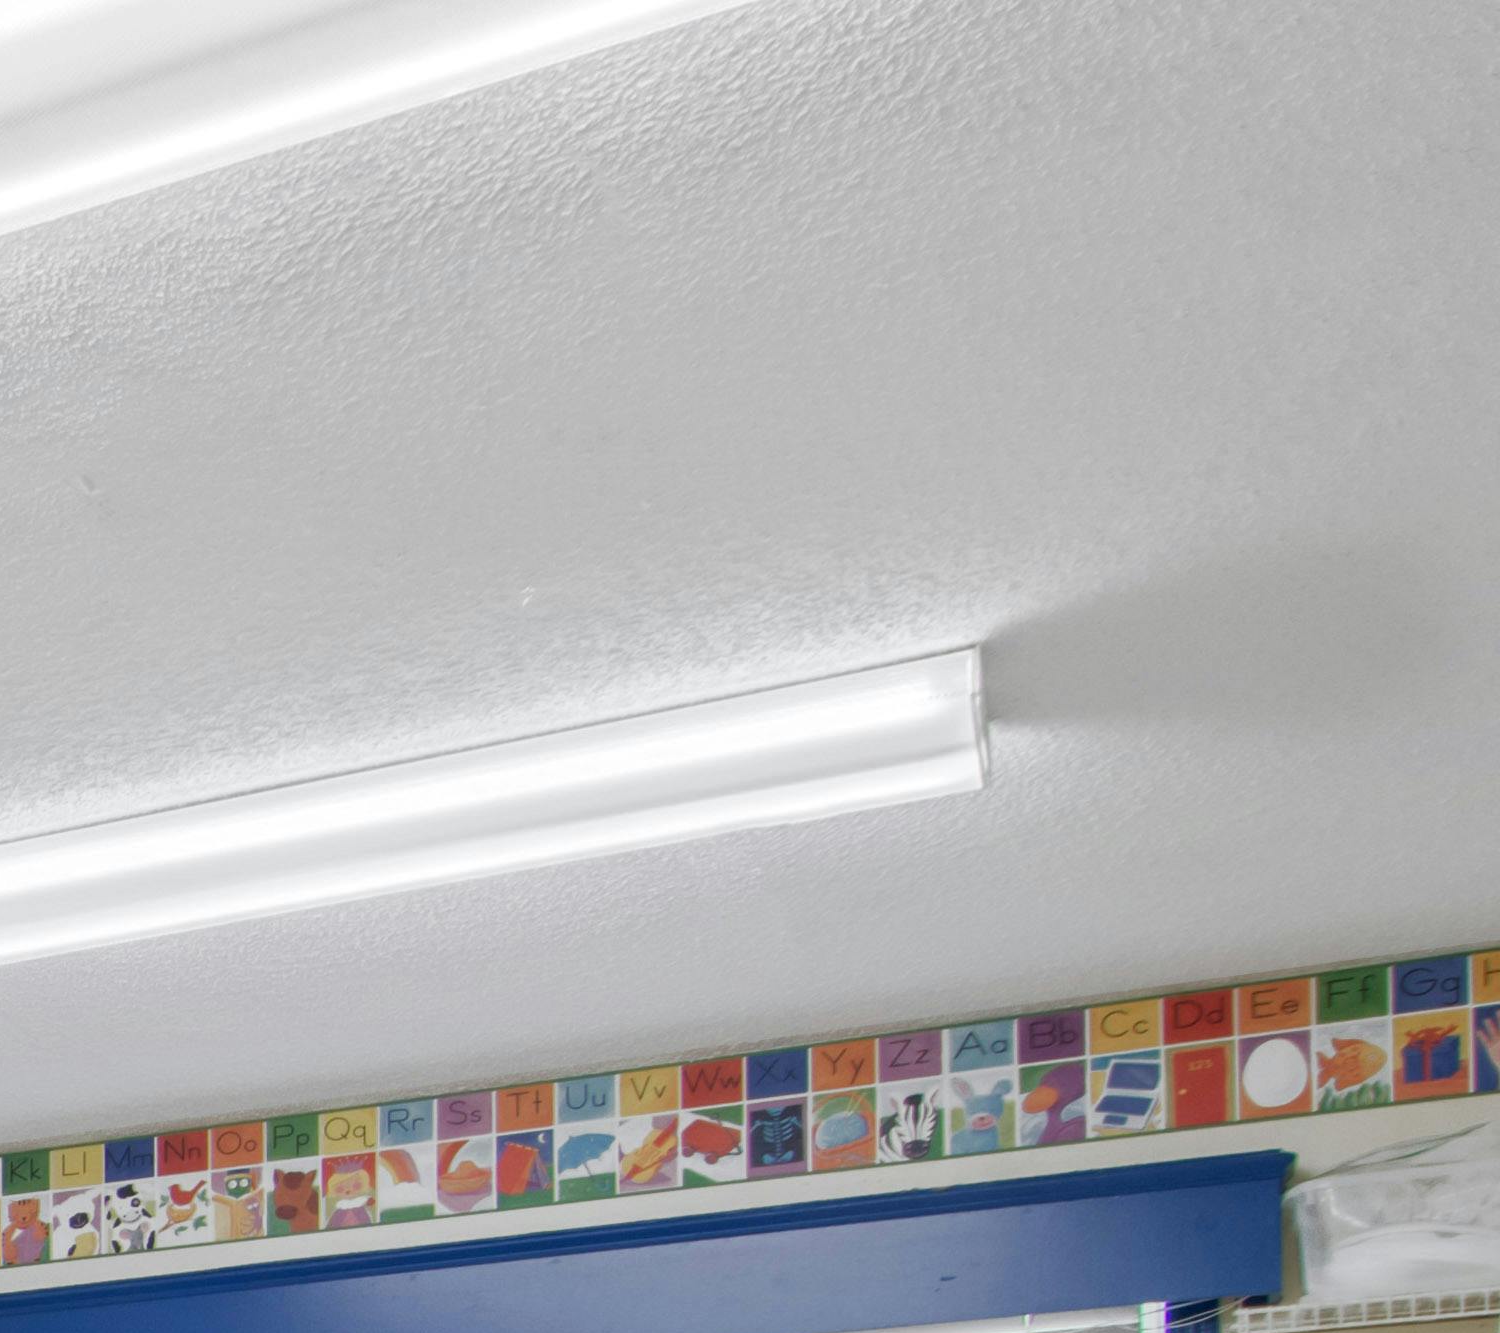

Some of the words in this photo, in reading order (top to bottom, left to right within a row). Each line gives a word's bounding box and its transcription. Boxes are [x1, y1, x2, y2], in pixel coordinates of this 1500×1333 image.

[9, 1160, 41, 1183] Kk
[61, 1151, 88, 1176] Ll
[163, 1139, 201, 1163] Nn
[216, 1130, 257, 1155] Oo
[273, 1123, 310, 1155] Pp
[324, 1116, 374, 1149] Qq
[388, 1107, 425, 1131] Rr
[448, 1101, 482, 1125] Ss
[508, 1091, 543, 1116] Tt
[565, 1086, 607, 1112] Uu
[629, 1077, 666, 1100] Vv
[684, 1066, 741, 1093] Ww
[823, 1050, 865, 1087] Yy
[889, 1039, 930, 1067] Zz
[955, 1032, 1008, 1059] Aa
[1100, 1009, 1149, 1038] Cc
[1173, 998, 1225, 1027] Dd
[1251, 988, 1299, 1019] Ee
[1324, 976, 1372, 1005] Ff
[1400, 968, 1462, 1004] Gg
